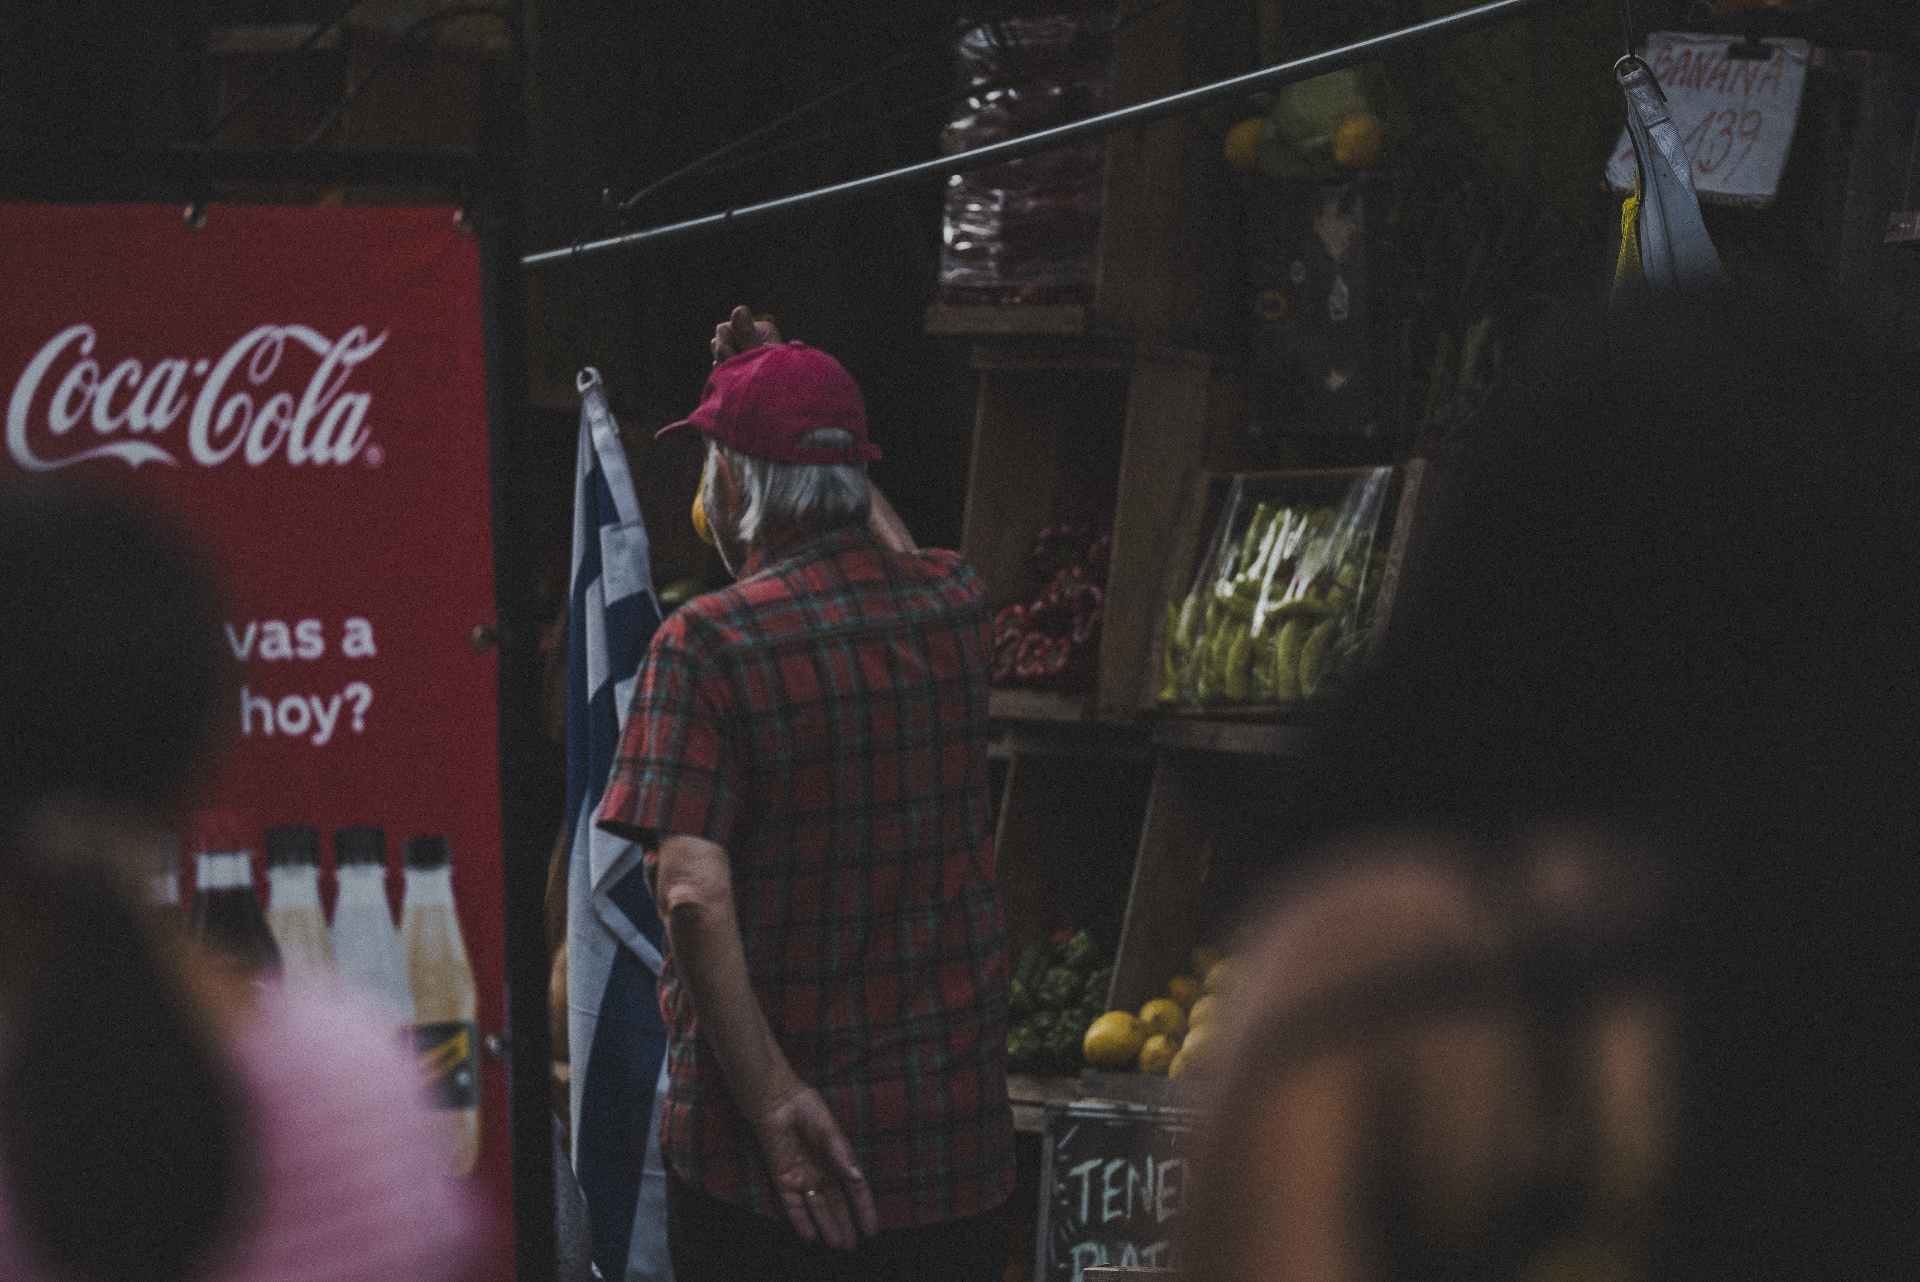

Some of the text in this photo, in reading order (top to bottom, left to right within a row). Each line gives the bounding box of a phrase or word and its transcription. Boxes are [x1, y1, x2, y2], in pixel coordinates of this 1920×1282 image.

[1653, 44, 1786, 96] BANANA
[6, 323, 390, 471] Coca-Cola
[224, 616, 377, 661] vas a
[240, 681, 374, 747] hoy?
